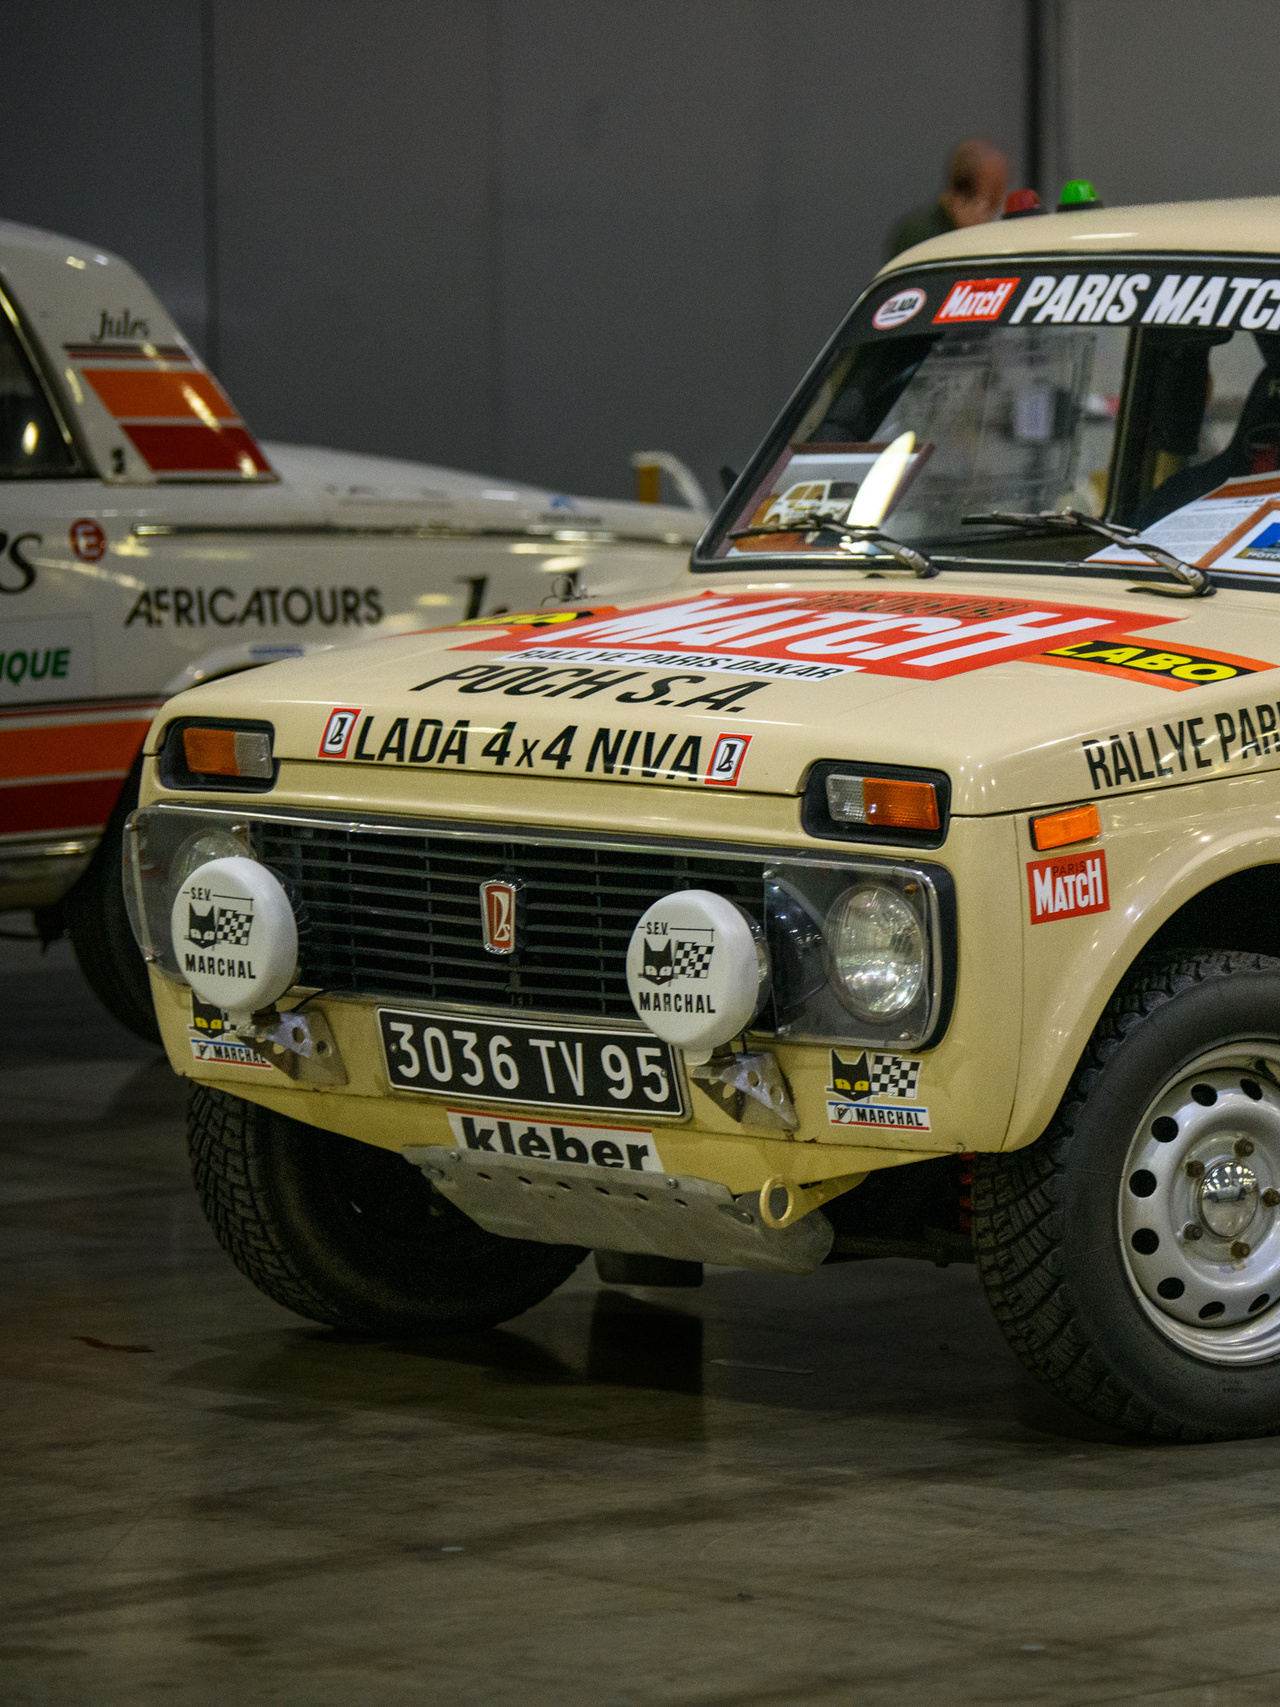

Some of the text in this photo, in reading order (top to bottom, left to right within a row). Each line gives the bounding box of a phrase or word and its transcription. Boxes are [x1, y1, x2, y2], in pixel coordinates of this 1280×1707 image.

[939, 282, 1014, 319] MATCH
[1008, 274, 1146, 324] PARIS
[124, 586, 385, 629] AFRICATOURS
[519, 597, 1117, 666] MATCH
[507, 649, 845, 680] RALLYE PARIS DAKAR
[1042, 641, 1239, 682] LABO
[410, 664, 773, 713] POCH S.A.
[353, 715, 703, 782] LADA 4x4 NIVA
[1082, 716, 1214, 791] RALLYE
[1033, 857, 1104, 916] MATCH
[1052, 861, 1086, 876] PARIS
[185, 953, 256, 980] MARCHAL
[639, 992, 716, 1014] MARCHAL
[388, 1022, 670, 1103] 3036 TV 95
[856, 1107, 924, 1128] MARCHAL
